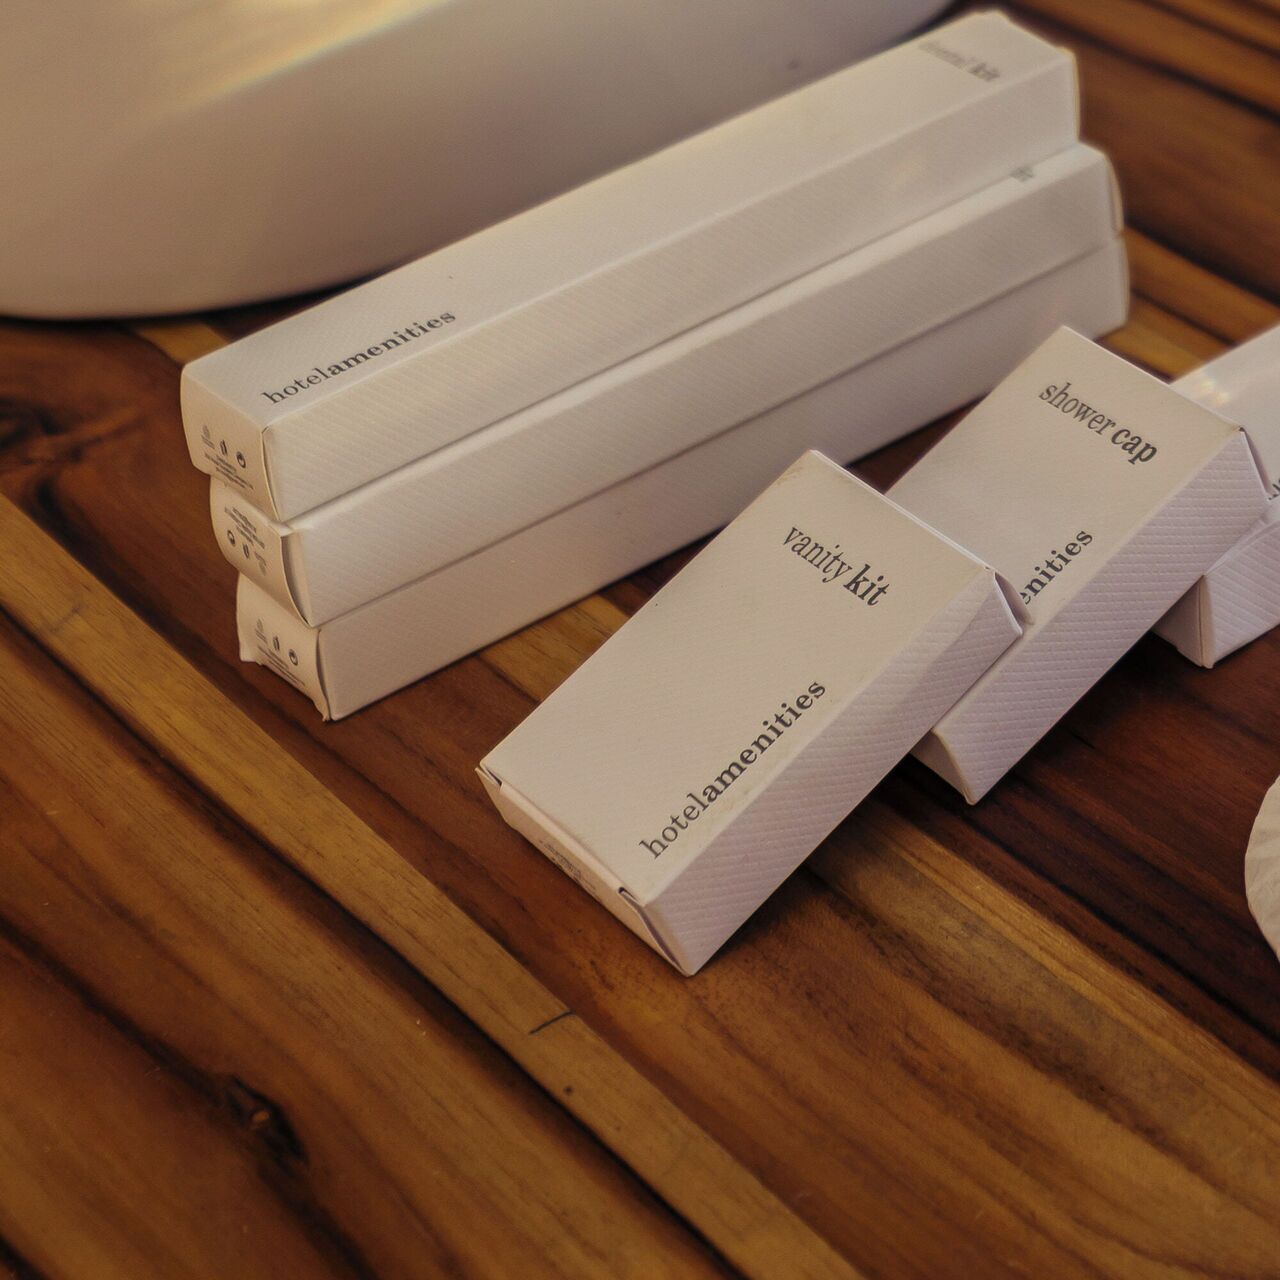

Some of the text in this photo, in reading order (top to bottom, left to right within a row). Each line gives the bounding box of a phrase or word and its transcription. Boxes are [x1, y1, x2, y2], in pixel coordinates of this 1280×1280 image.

[261, 312, 456, 404] hotelamenities
[1038, 382, 1158, 465] shower cap
[783, 526, 890, 606] vanity kit
[639, 681, 826, 859] hotelamenities
